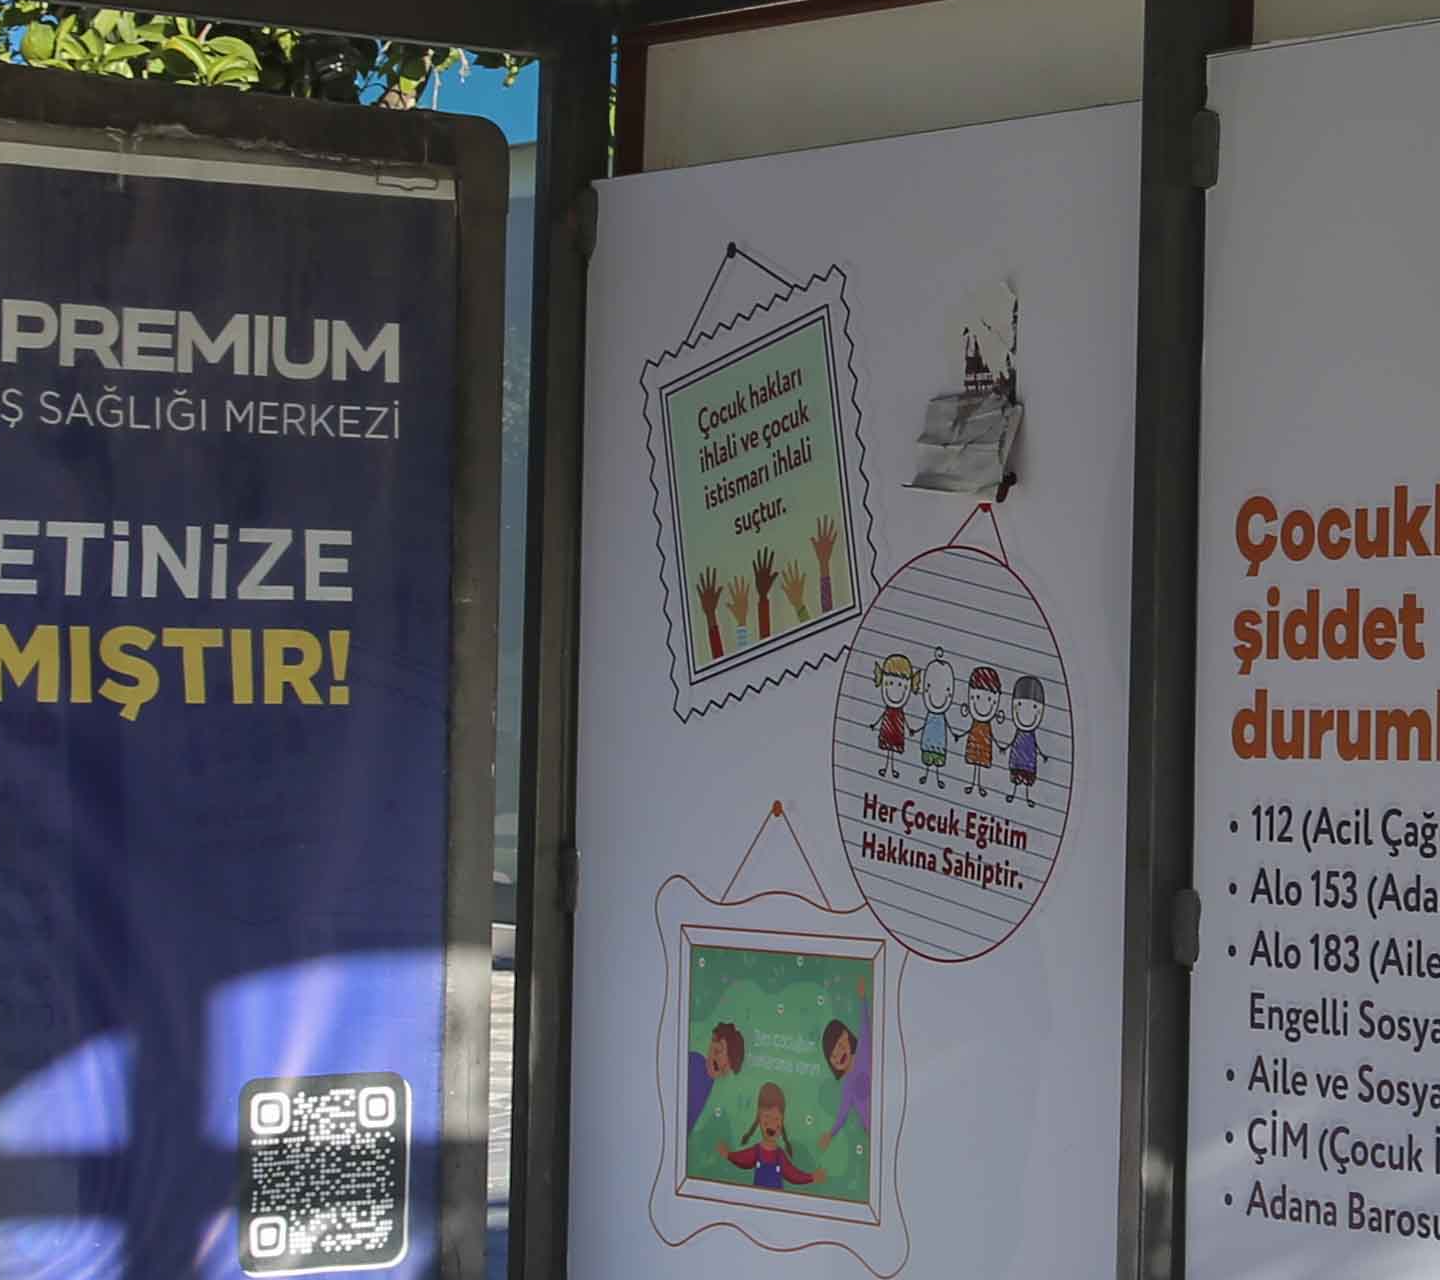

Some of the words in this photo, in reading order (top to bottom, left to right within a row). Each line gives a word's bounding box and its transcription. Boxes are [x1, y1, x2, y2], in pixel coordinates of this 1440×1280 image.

[3, 298, 400, 383] PREMIUM
[40, 384, 207, 434] SAĞLIĞI
[225, 396, 400, 440] MERKEZİ
[698, 390, 748, 440] Çocuk
[748, 368, 803, 410] hakları
[699, 433, 738, 473] ihlali
[740, 430, 759, 452] ve
[762, 400, 809, 449] çocuk
[704, 463, 770, 510] istismarı
[772, 436, 812, 477] ihlali
[734, 497, 787, 535] suçtur.
[1232, 586, 1426, 674] şiddet
[863, 792, 897, 824] Her
[902, 800, 960, 837] Çocuk
[965, 811, 1028, 850] Eğitim
[1250, 805, 1293, 843] 112
[1302, 808, 1373, 851] (Acil
[862, 831, 937, 872] Hakkına
[942, 847, 1024, 890] Sahiptir.
[1250, 867, 1302, 908] Alo
[1311, 871, 1358, 910] 153
[1250, 929, 1302, 970] Alo
[1310, 934, 1360, 974] 183
[1249, 992, 1349, 1042] Engelli
[1248, 1055, 1307, 1099] Aile
[1315, 1072, 1349, 1103] ve
[1248, 1117, 1309, 1169] ÇİM
[1318, 1125, 1424, 1175] (Çocuk
[1246, 1180, 1338, 1228] Adana
